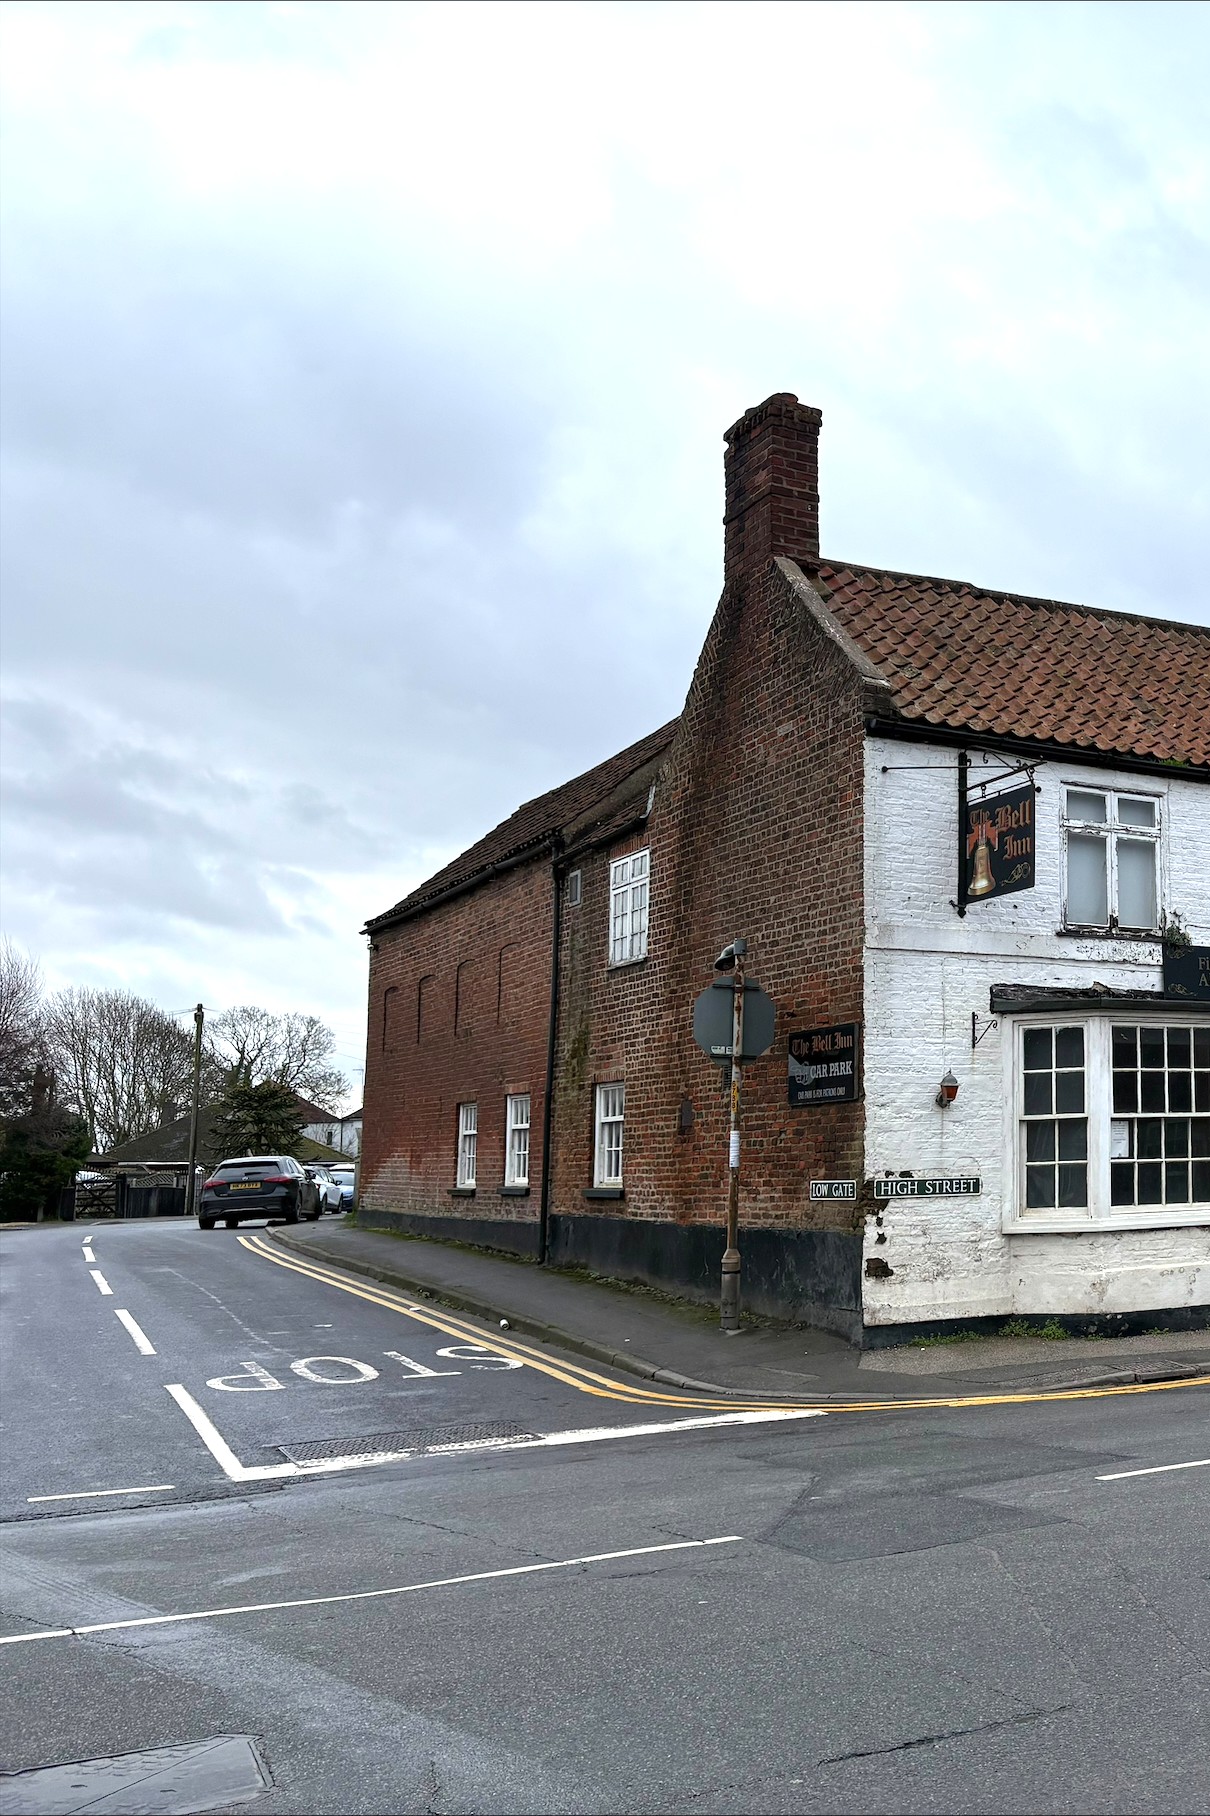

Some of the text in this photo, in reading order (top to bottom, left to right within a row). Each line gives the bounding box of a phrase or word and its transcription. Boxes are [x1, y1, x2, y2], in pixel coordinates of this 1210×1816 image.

[969, 799, 1032, 833] The Bell
[1003, 835, 1032, 861] Inn
[792, 1031, 853, 1057] The Bell Inn
[809, 1060, 853, 1079] CAR PARK
[812, 1183, 854, 1197] LOW GATE
[880, 1179, 977, 1195] HIGH STREET
[206, 1345, 524, 1392] STOP
